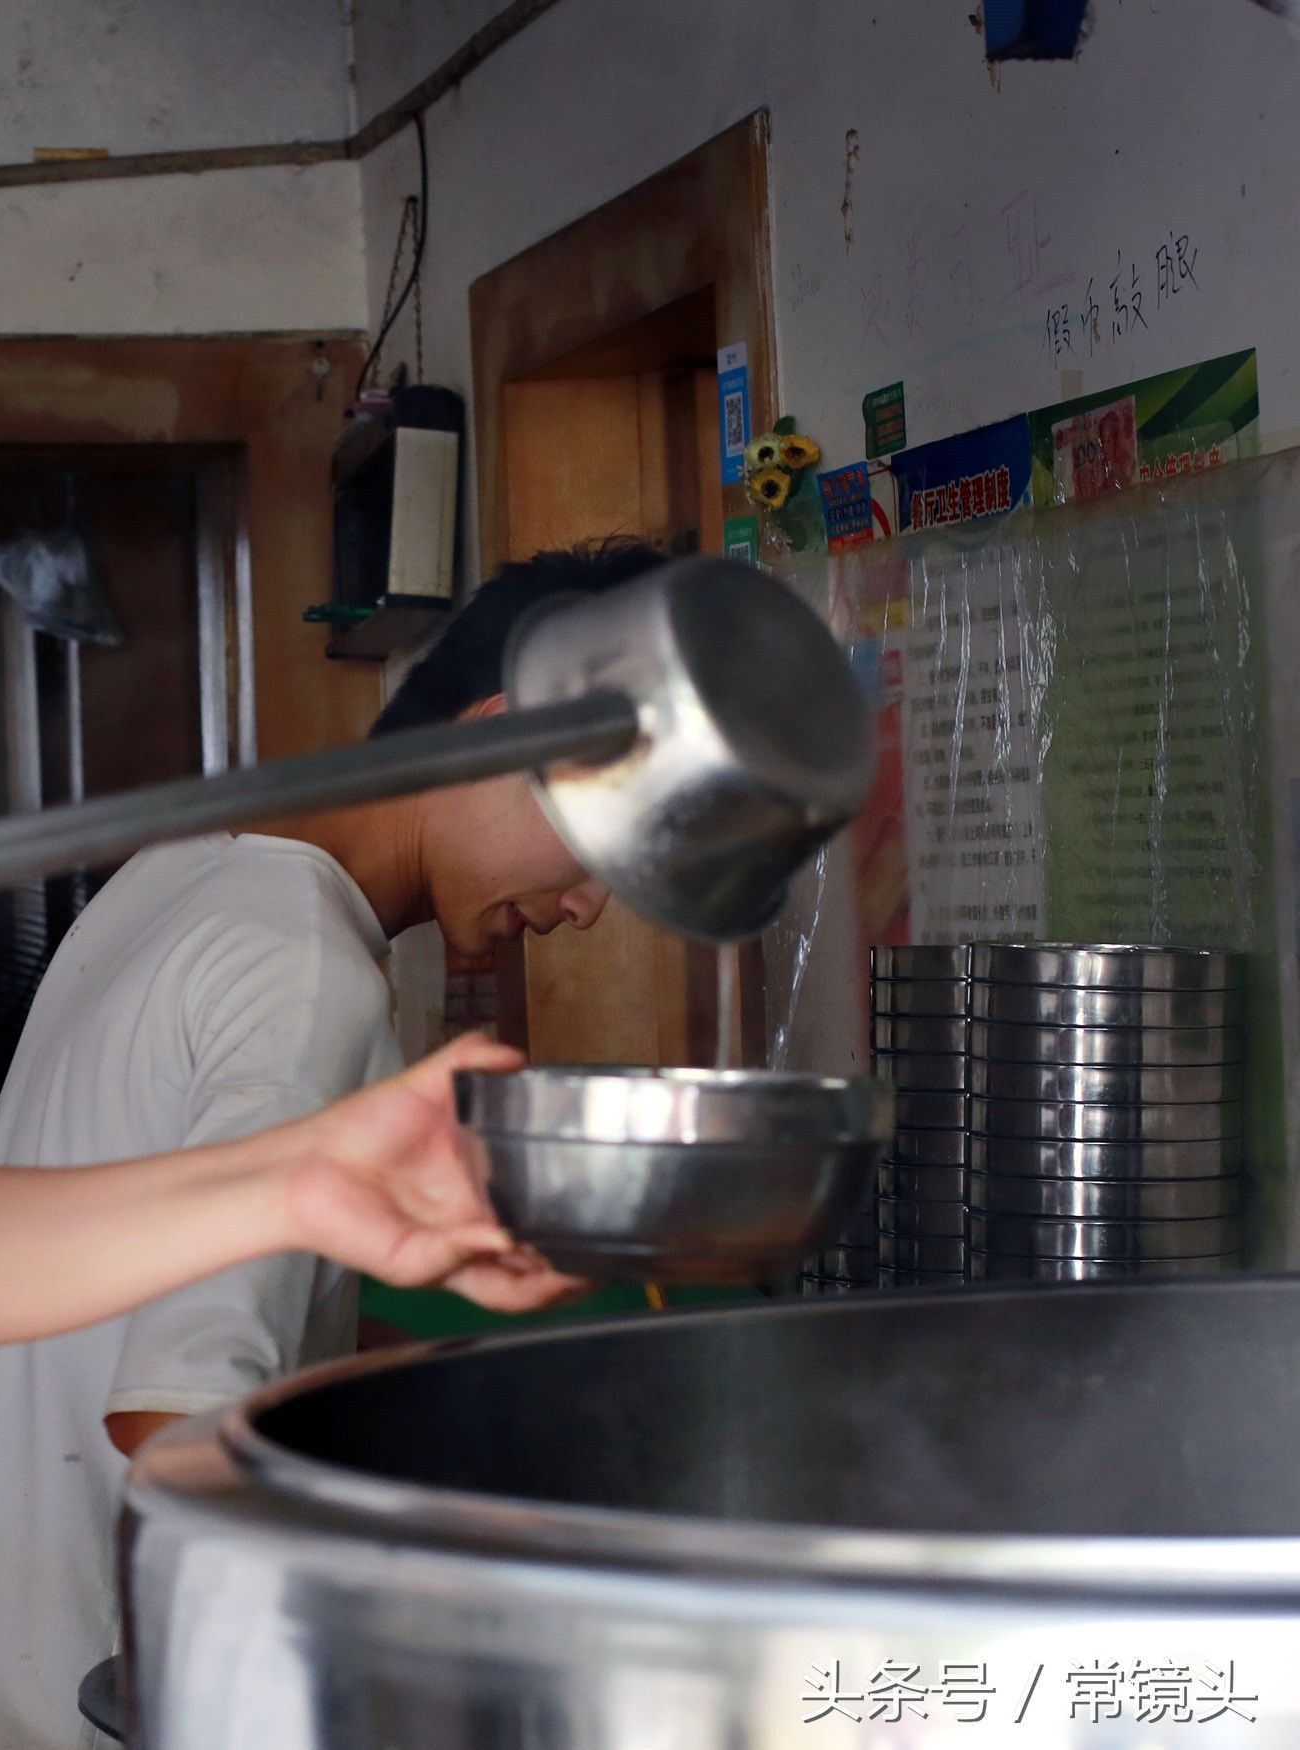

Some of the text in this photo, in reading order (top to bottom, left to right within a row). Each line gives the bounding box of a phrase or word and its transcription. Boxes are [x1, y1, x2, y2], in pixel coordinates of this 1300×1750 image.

[911, 464, 1012, 532] 餐厅卫生管理制度
